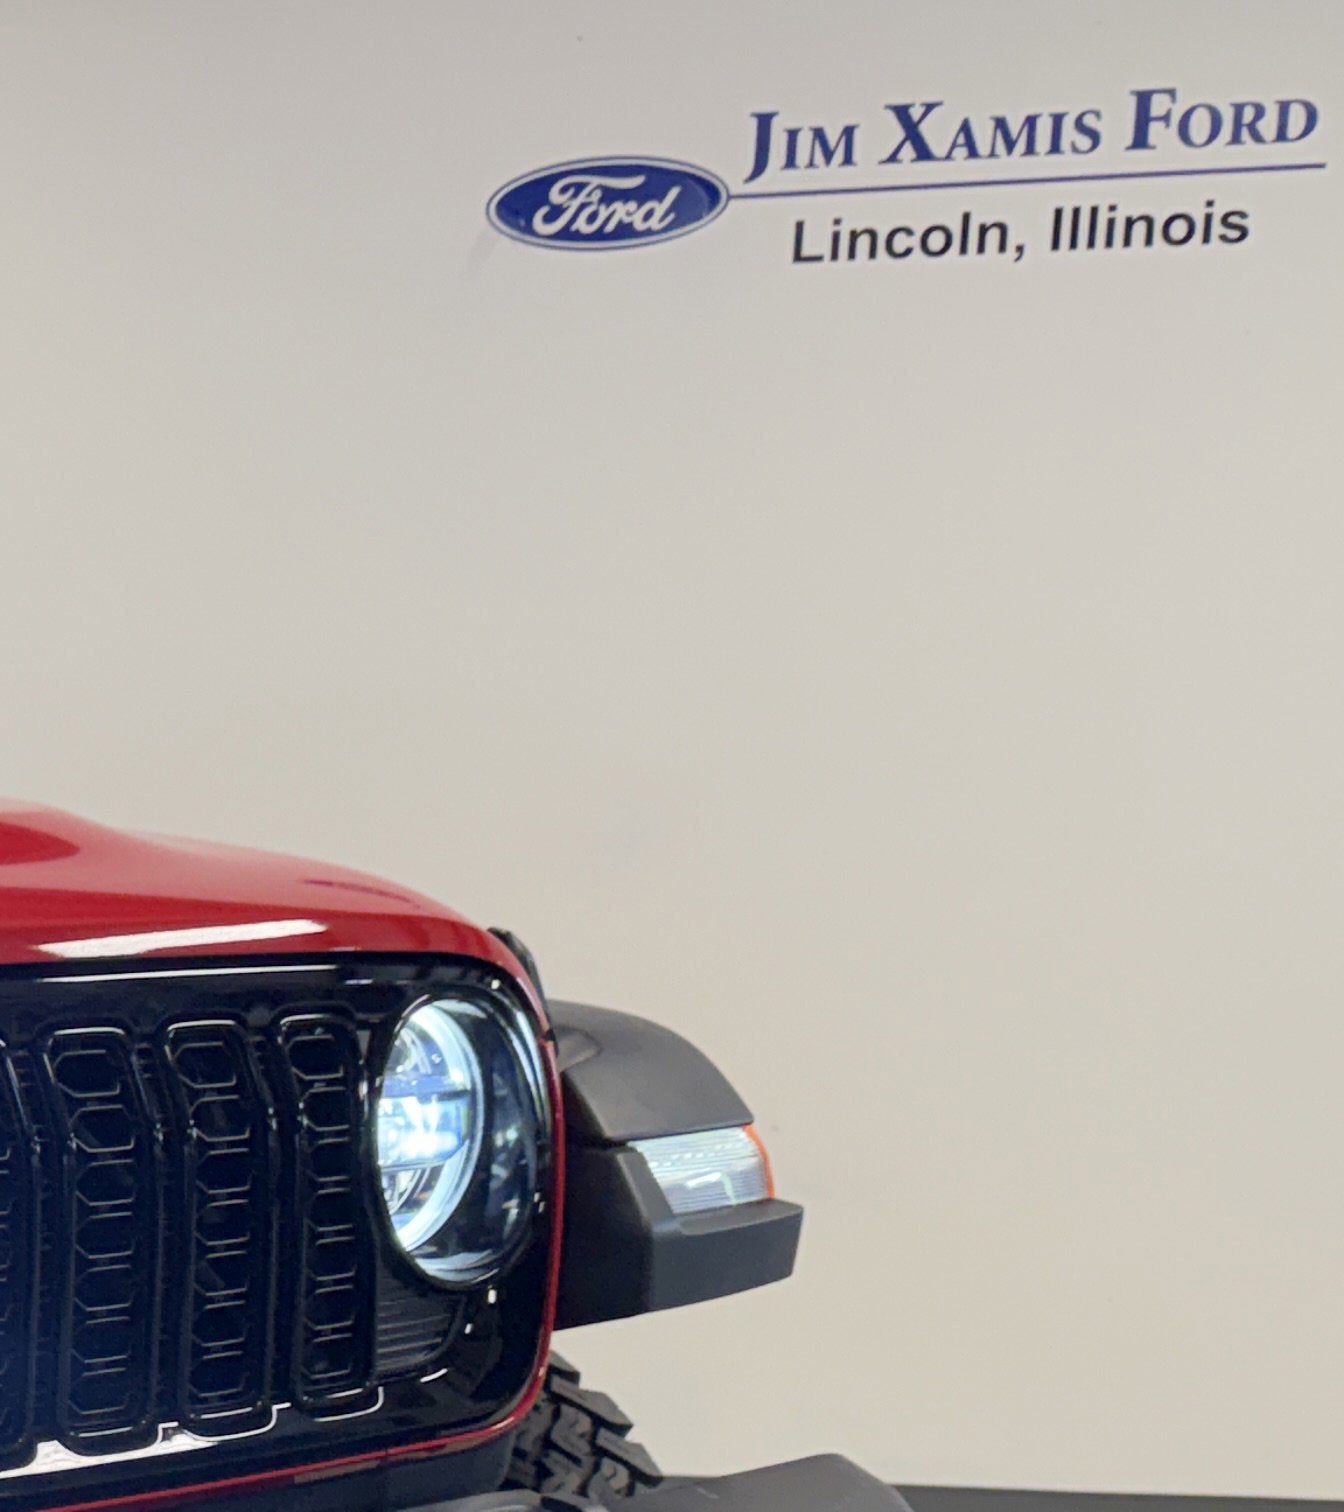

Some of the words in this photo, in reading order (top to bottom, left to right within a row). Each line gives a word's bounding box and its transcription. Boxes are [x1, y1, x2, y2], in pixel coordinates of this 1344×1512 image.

[743, 111, 860, 184] JIM
[878, 101, 1102, 164] XAMIS
[1125, 88, 1318, 151] FORD
[532, 174, 681, 236] Ford
[792, 211, 1024, 264] Lincoln,
[1050, 199, 1250, 251] Illinois
